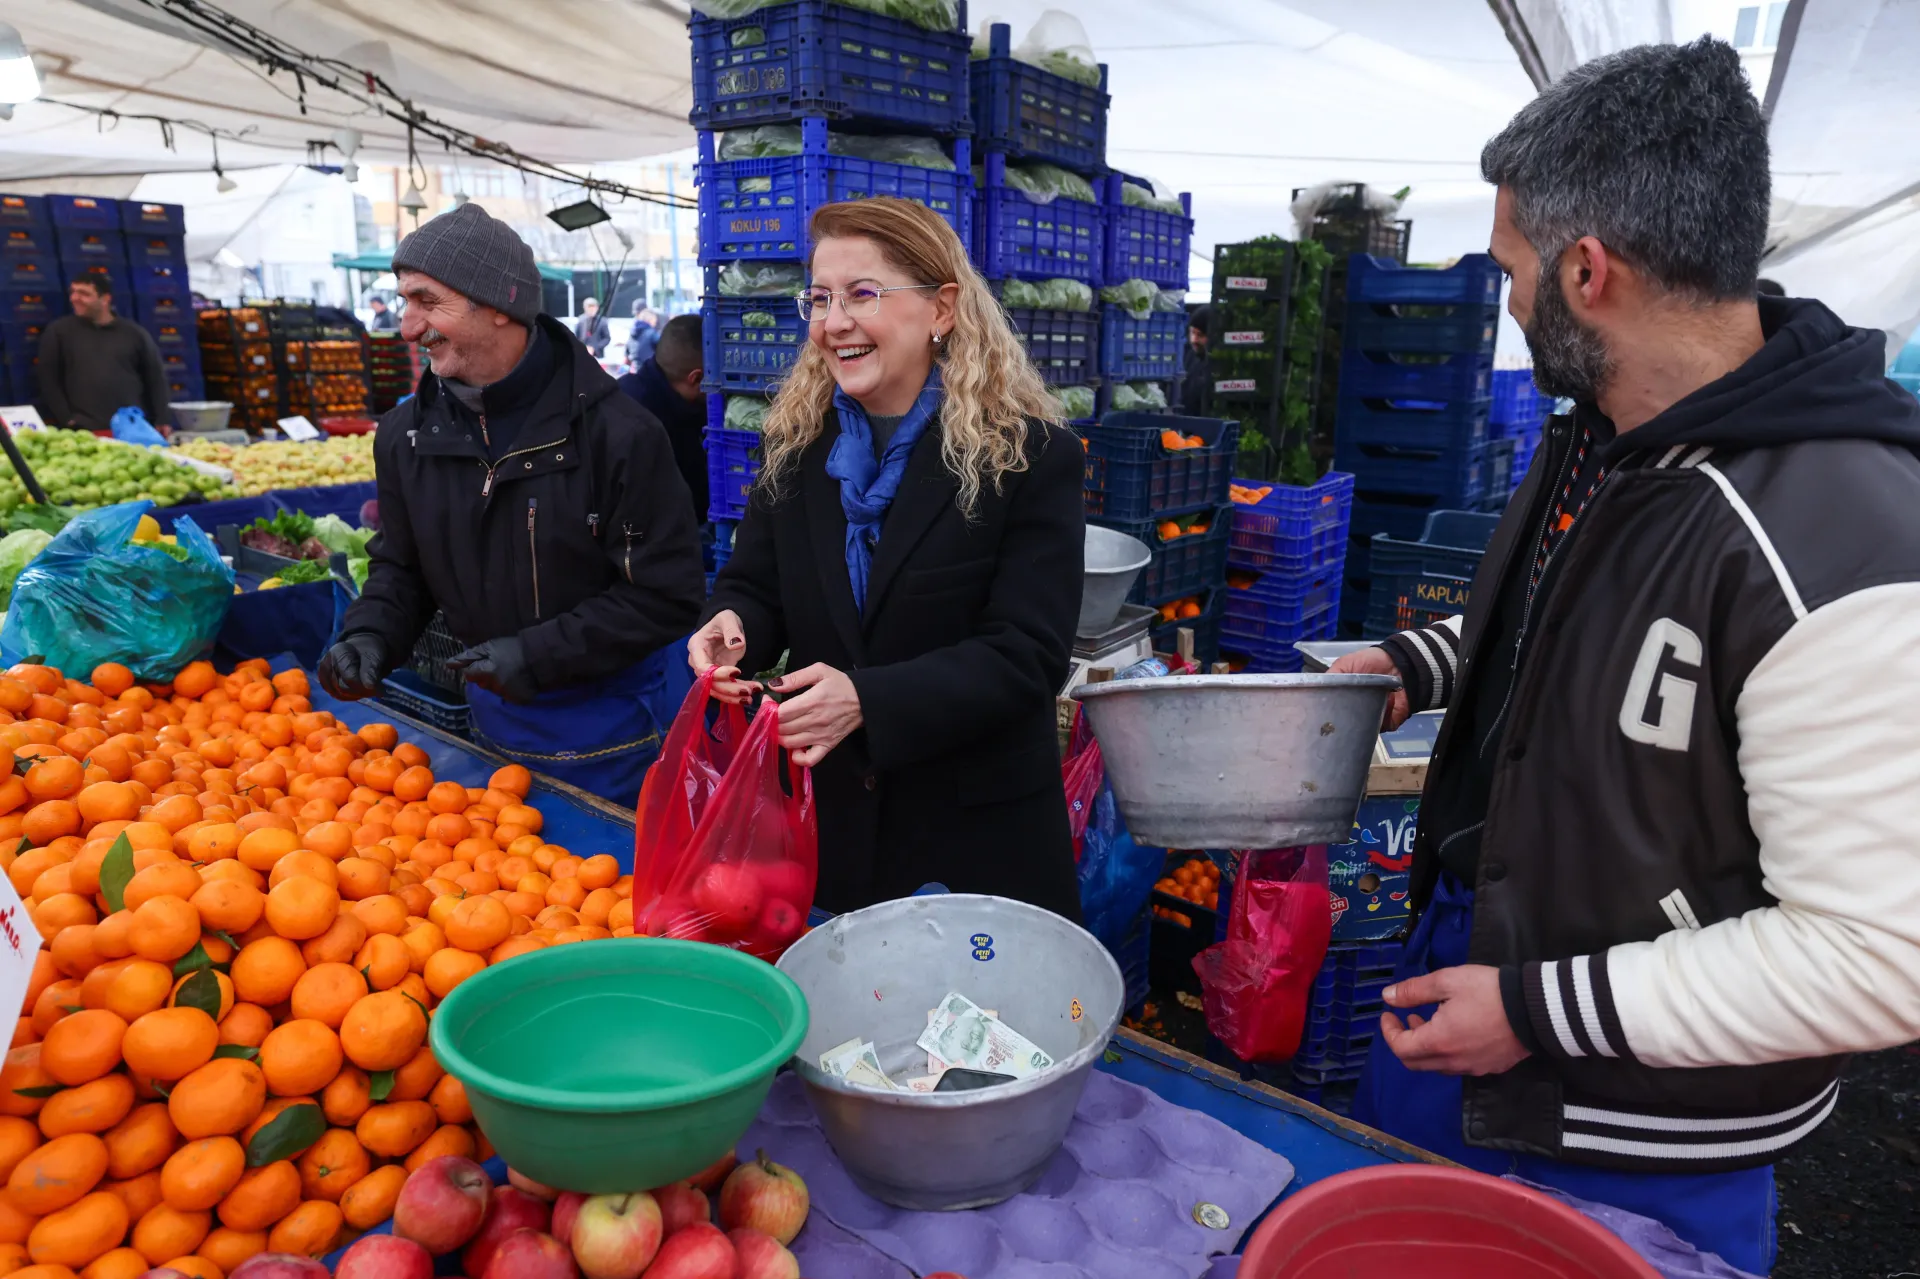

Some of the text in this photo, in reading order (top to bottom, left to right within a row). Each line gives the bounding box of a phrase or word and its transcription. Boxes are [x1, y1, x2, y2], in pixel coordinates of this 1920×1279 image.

[763, 217, 781, 232] 196
[1619, 617, 1703, 752] G
[986, 1056, 1001, 1070] 20
[1031, 1052, 1050, 1070] 20
